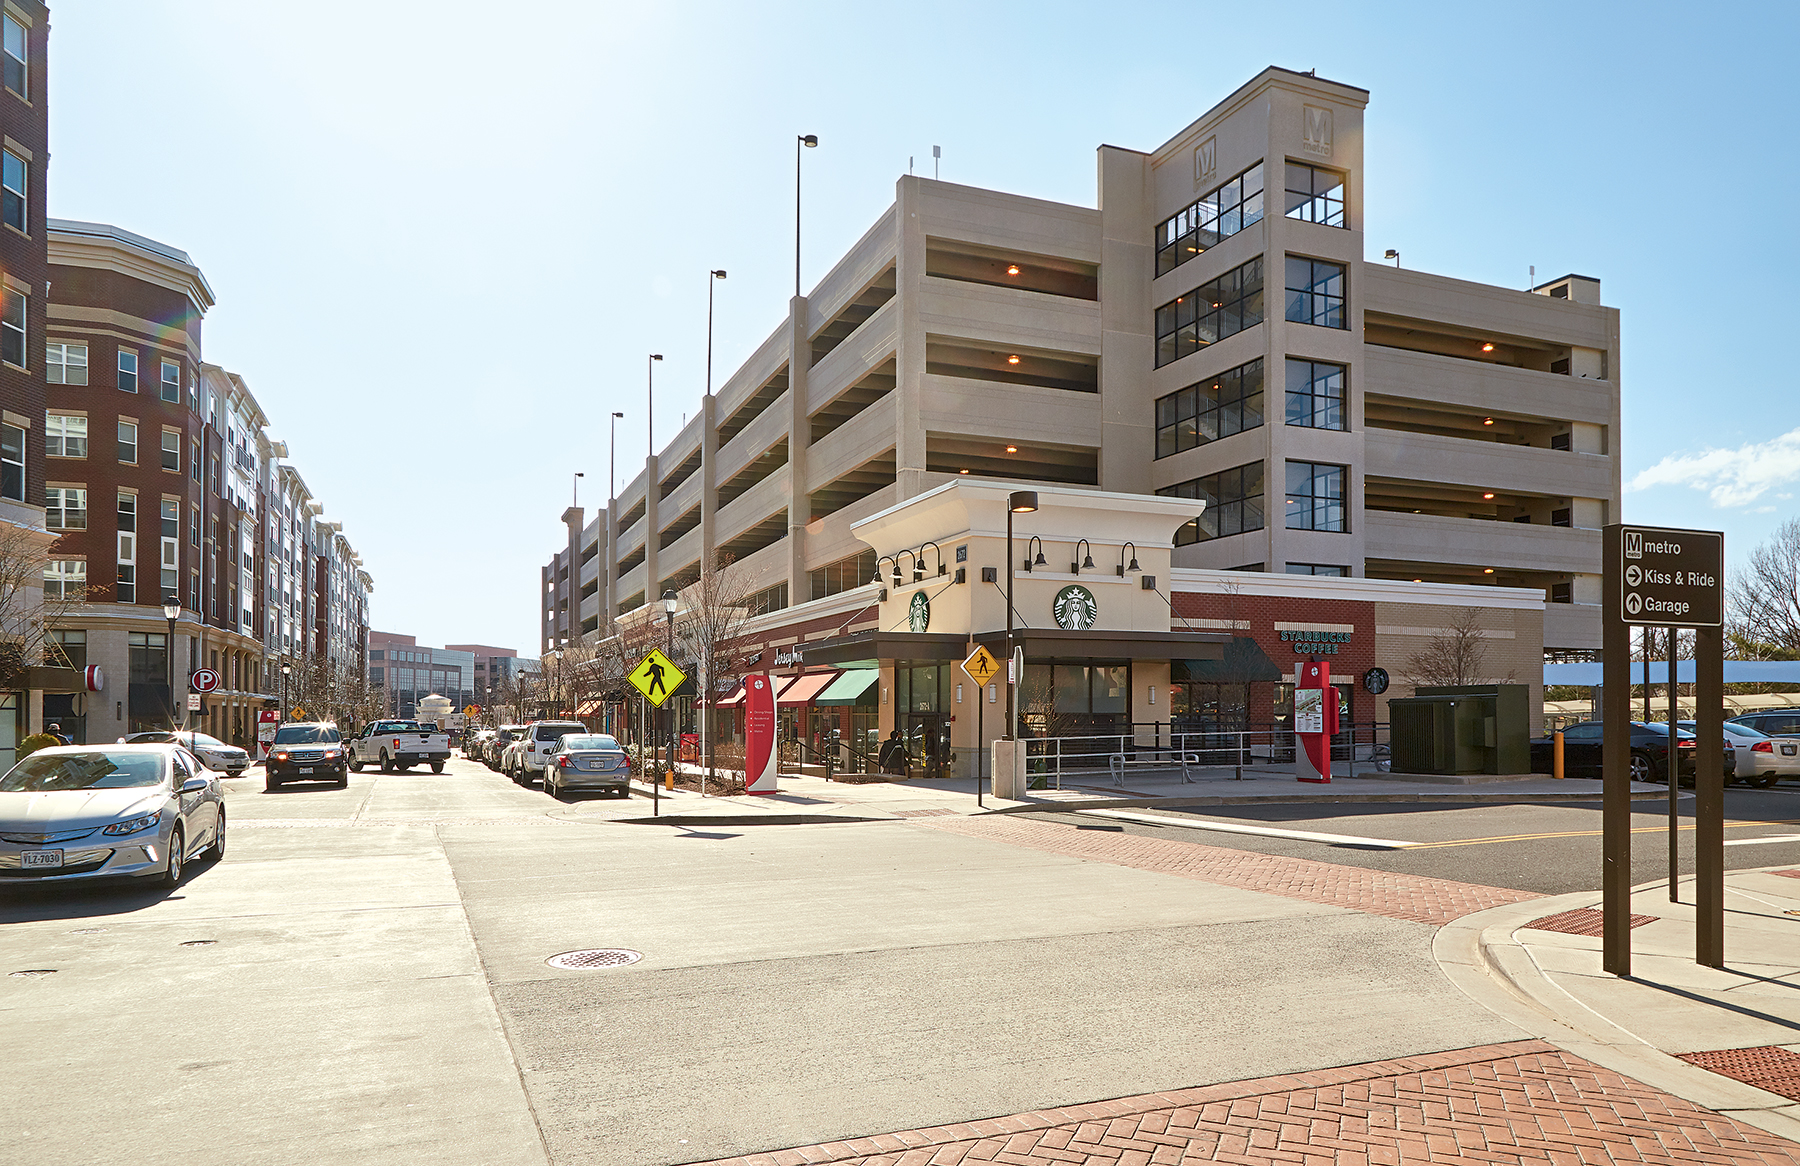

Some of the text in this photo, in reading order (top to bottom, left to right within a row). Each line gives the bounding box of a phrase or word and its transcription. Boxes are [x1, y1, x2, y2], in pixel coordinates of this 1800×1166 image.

[1304, 107, 1330, 145] M
[1303, 142, 1330, 155] metro
[1644, 540, 1681, 555] metro
[1644, 569, 1715, 587] Kiss & Ride
[1644, 596, 1690, 616] Garage
[1281, 630, 1351, 643] STARBUCKS
[1294, 642, 1339, 654] COFFEE
[199, 672, 213, 689] P
[24, 854, 60, 864] VLZ-7030
